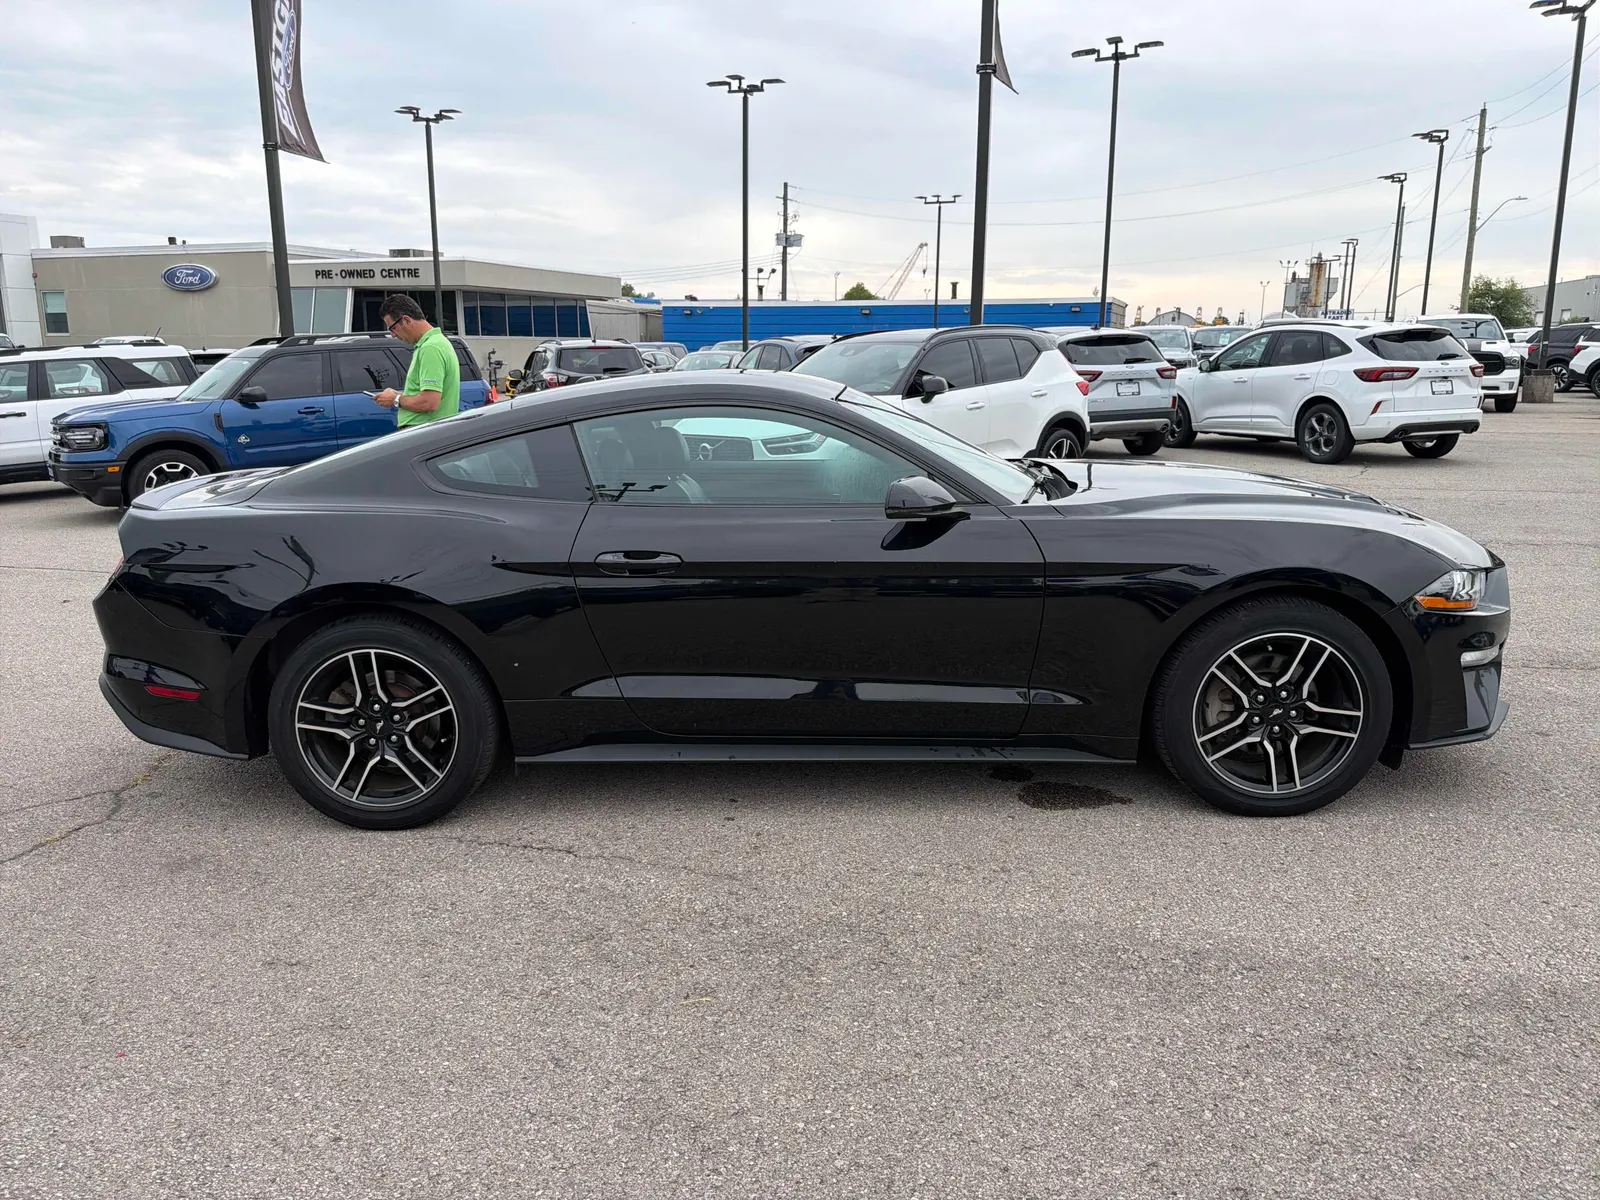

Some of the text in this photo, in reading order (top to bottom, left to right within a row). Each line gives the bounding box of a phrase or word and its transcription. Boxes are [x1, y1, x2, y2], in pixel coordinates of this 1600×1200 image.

[271, 0, 299, 141] EASTG
[174, 269, 201, 284] Ford
[315, 268, 420, 279] PRE-OWNED CENTRE
